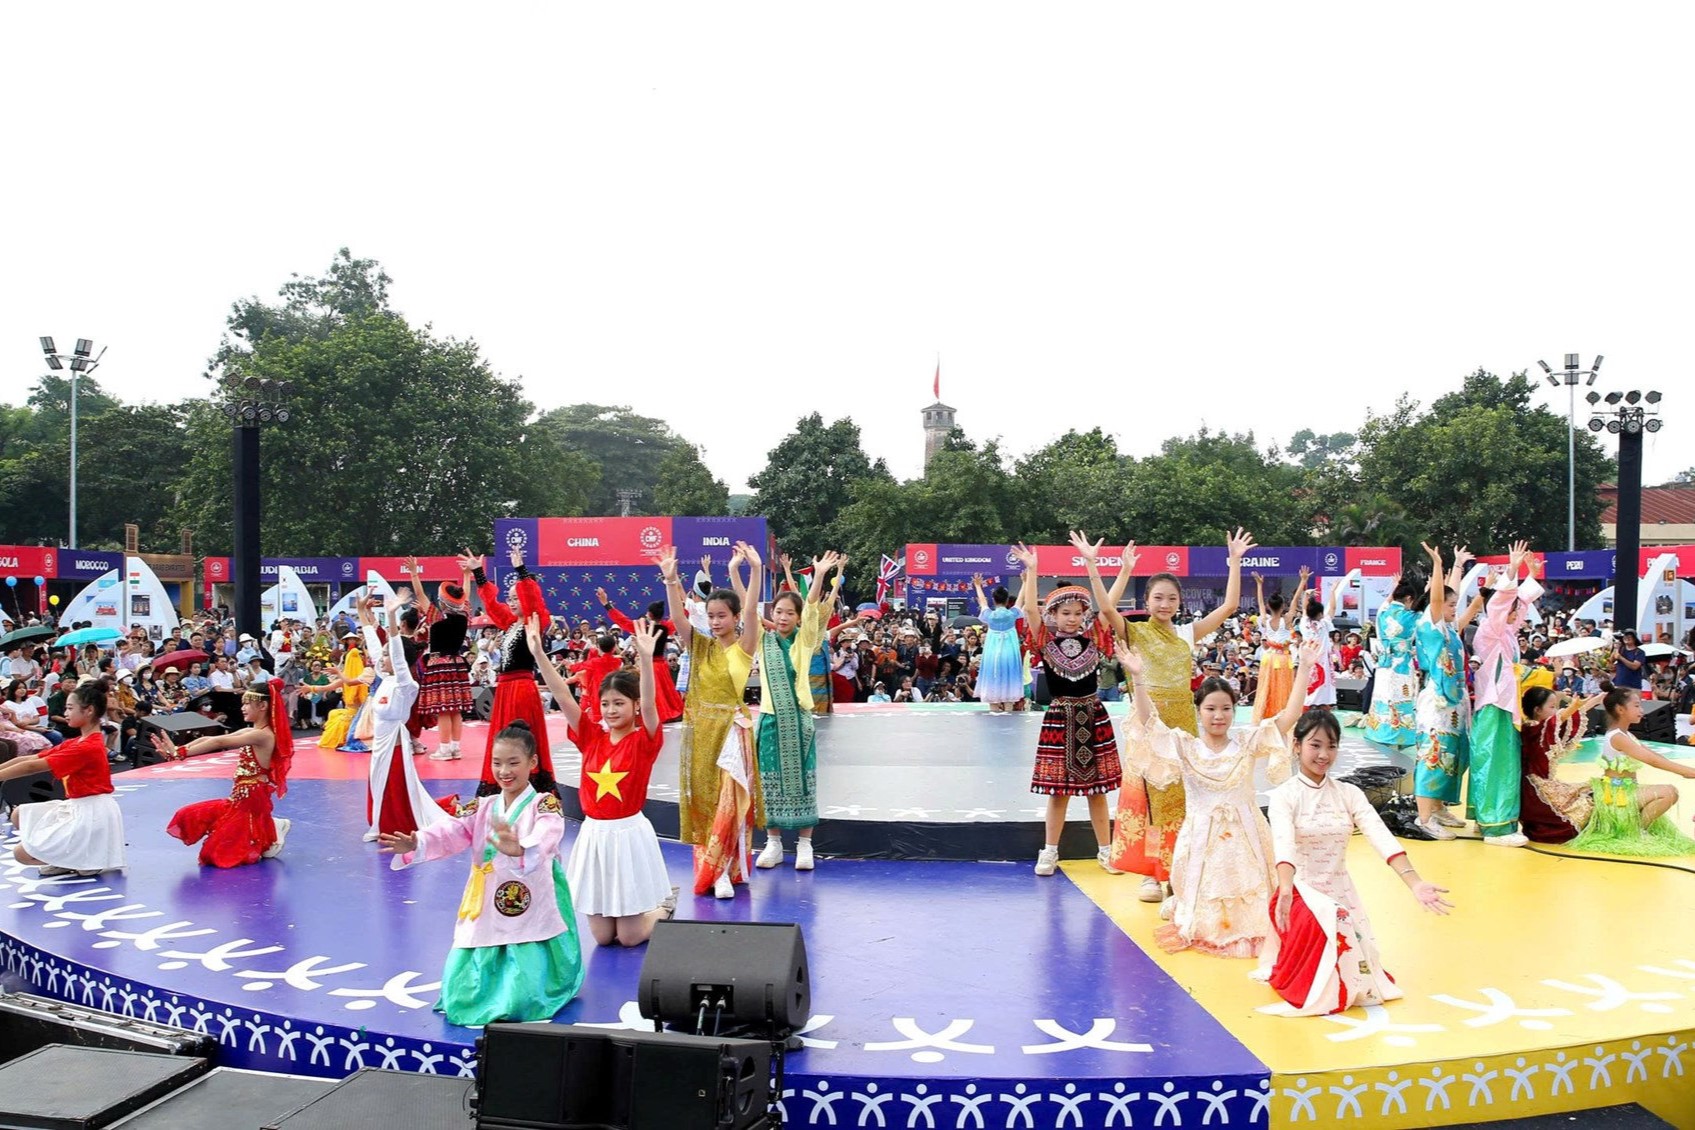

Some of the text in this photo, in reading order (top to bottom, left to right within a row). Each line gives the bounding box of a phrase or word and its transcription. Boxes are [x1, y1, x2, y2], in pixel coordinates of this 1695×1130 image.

[567, 537, 599, 547] CHINA
[703, 537, 730, 546] INDIA
[75, 560, 109, 570] MOROCCO
[1071, 556, 1123, 566] SEDEN
[1226, 557, 1279, 567] RAINE
[1566, 560, 1583, 570] PERU
[260, 566, 277, 574] UDI
